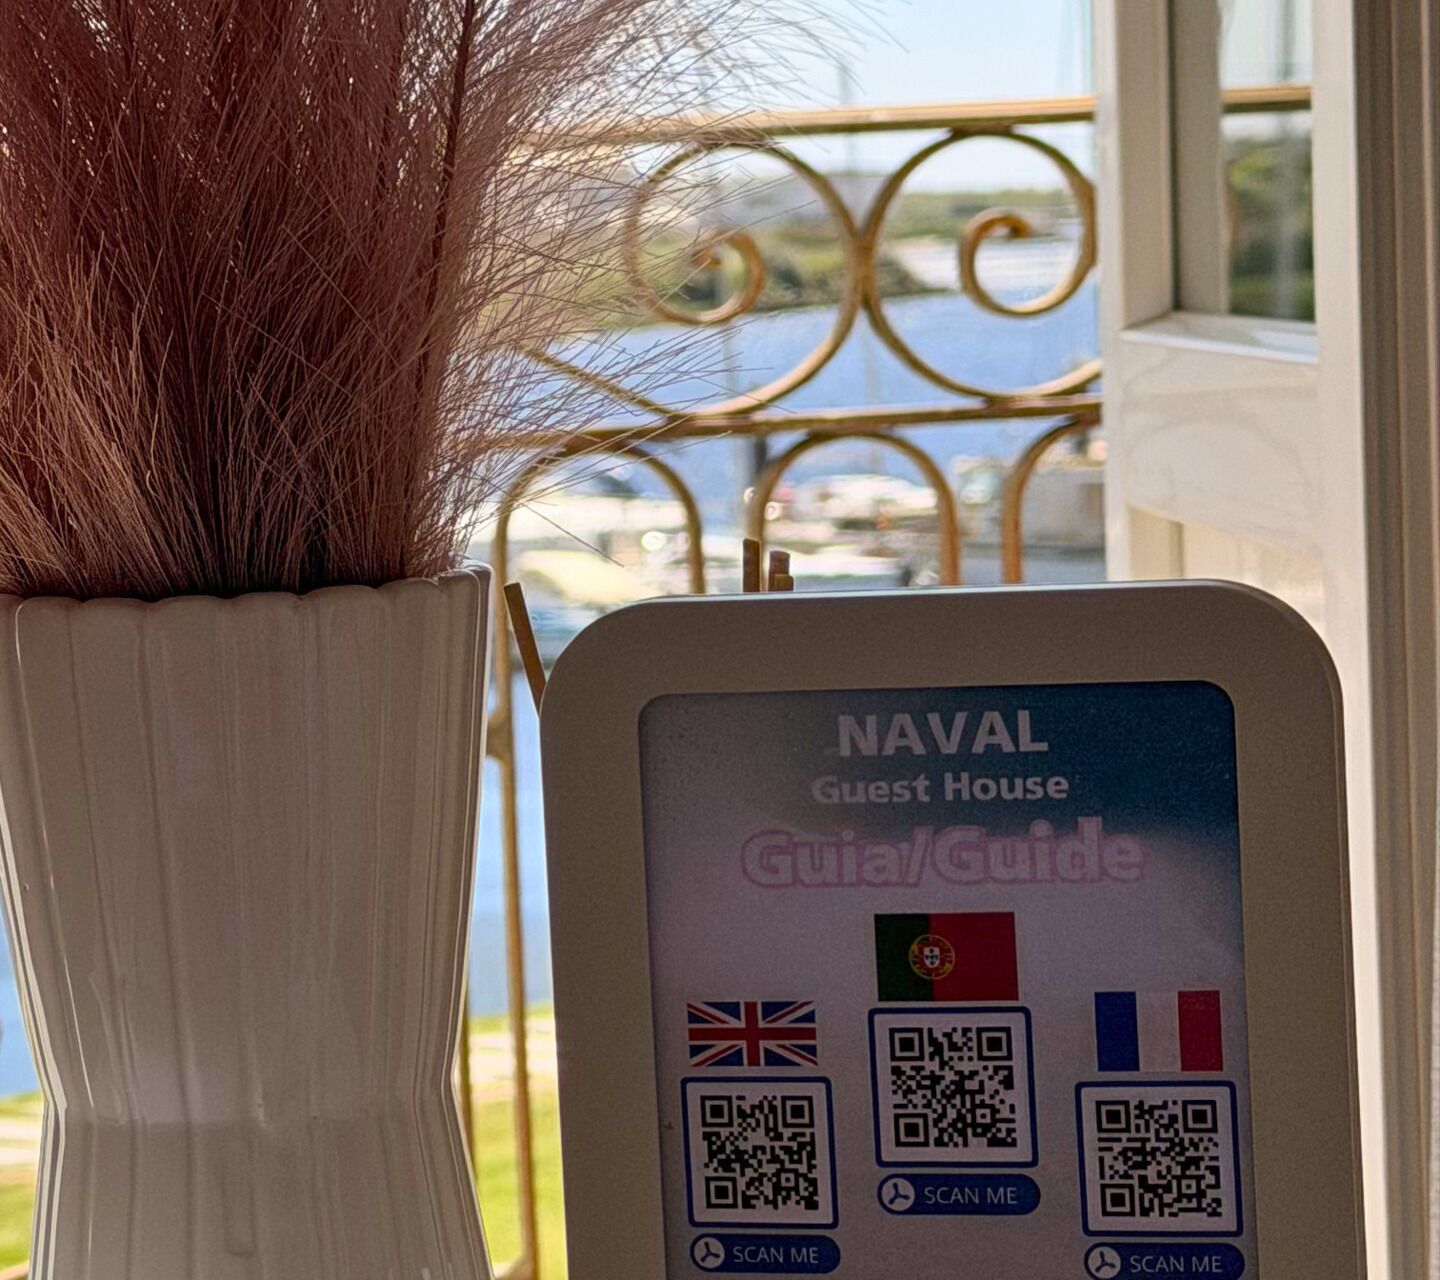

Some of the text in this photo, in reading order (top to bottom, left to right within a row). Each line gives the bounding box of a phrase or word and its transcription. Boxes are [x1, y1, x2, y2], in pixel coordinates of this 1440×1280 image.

[836, 708, 1050, 757] NAVAL
[810, 771, 1071, 805] Guest House
[923, 1186, 1018, 1205] SCAN ME
[732, 1246, 819, 1265] SCAN ME
[1129, 1255, 1223, 1273] SCAN ME
